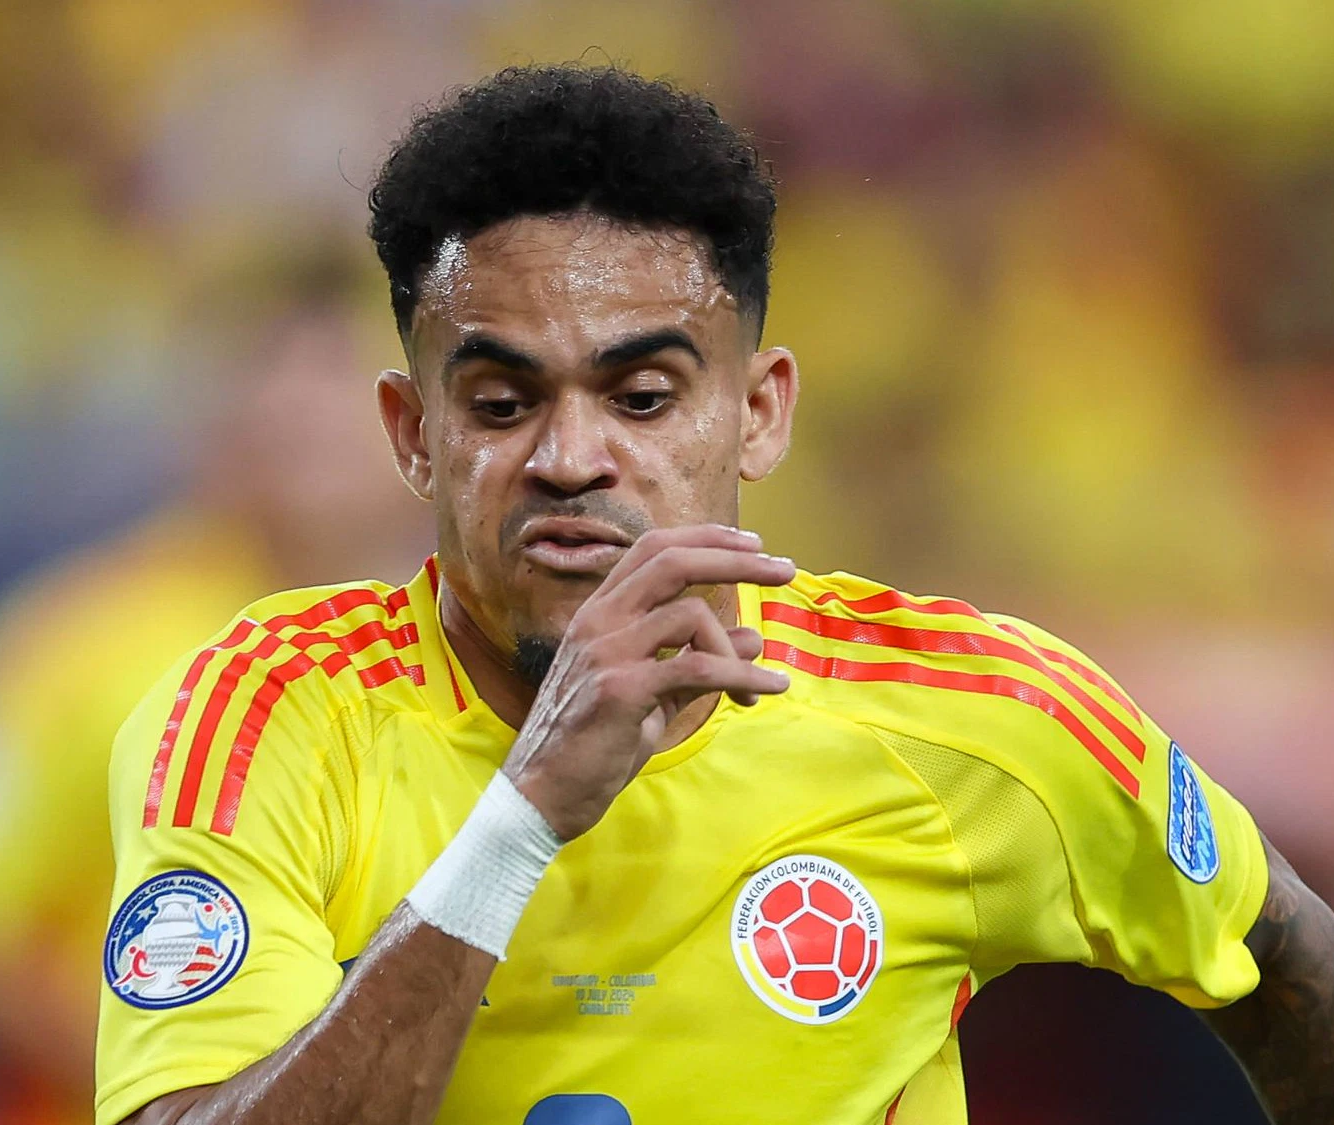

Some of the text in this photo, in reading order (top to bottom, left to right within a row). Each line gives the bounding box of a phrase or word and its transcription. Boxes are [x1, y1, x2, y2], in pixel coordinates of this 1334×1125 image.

[149, 879, 175, 892] COPA
[771, 861, 841, 882] COLOMBIANA
[842, 878, 857, 893] DE
